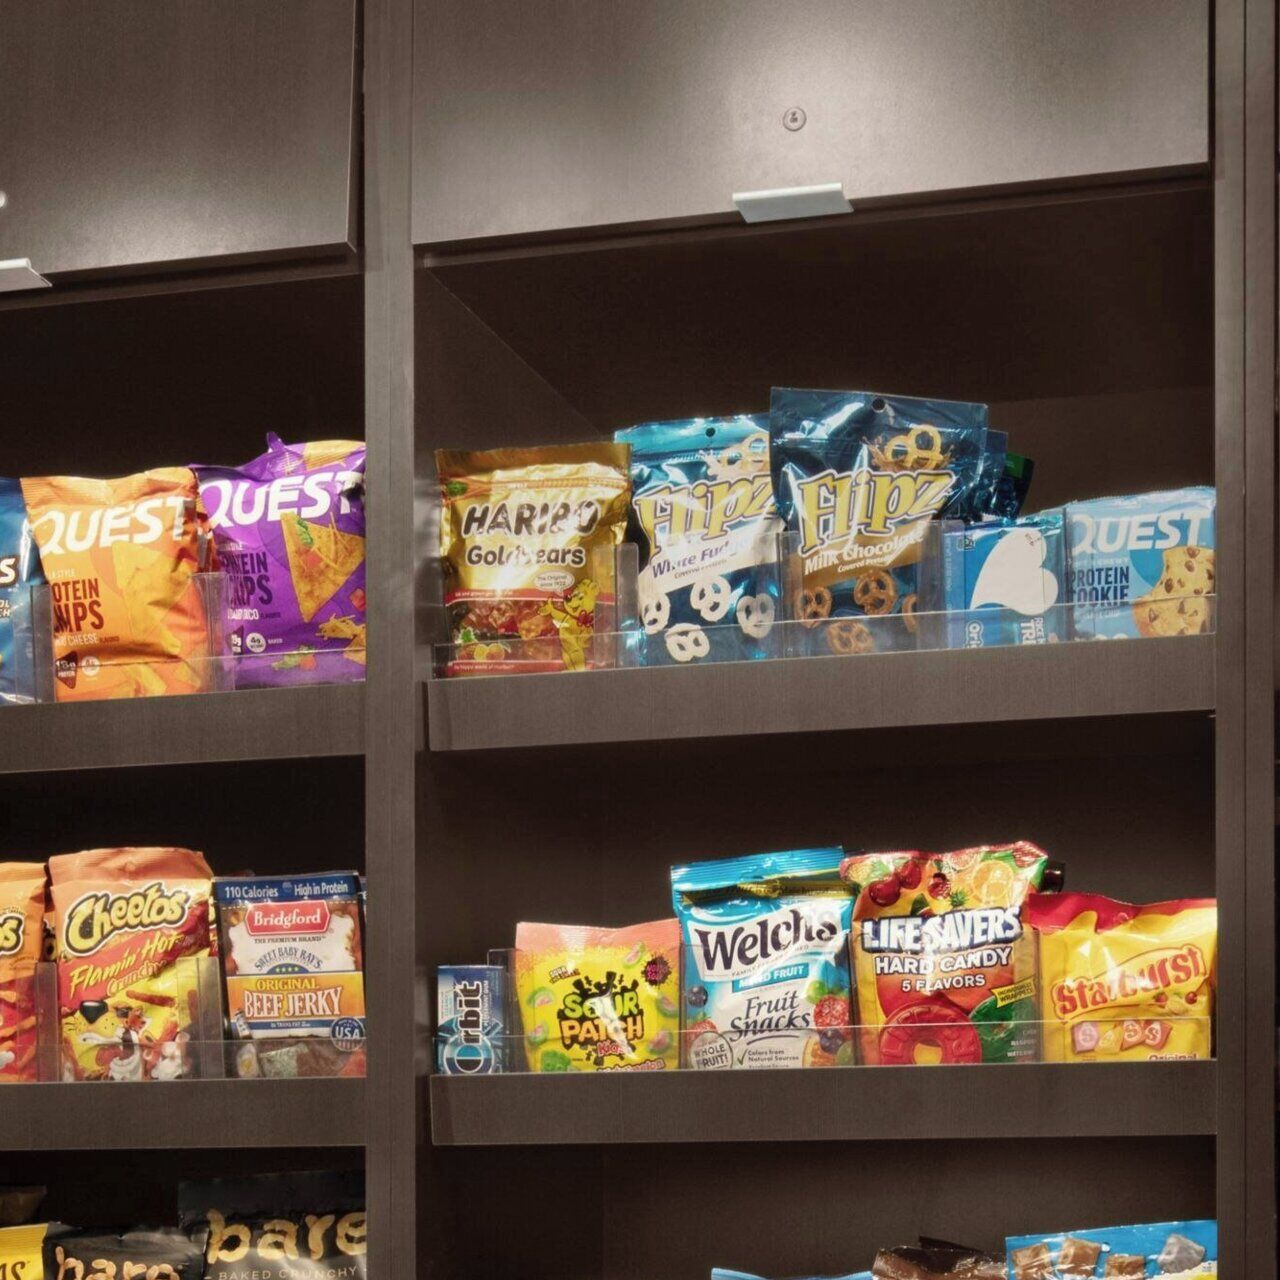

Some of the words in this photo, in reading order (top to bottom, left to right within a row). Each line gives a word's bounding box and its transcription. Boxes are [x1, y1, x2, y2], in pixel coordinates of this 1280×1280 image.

[199, 471, 365, 528] QUEST
[799, 470, 956, 556] Flipz
[32, 497, 195, 556] QUEST
[462, 500, 599, 538] HARIBO
[1071, 509, 1210, 556] QUEST
[805, 551, 839, 575] Milk
[225, 886, 240, 898] 110
[242, 886, 278, 898] Calories
[294, 884, 310, 896] High
[321, 881, 348, 893] Protein
[66, 883, 189, 953] Cheetos
[253, 908, 321, 928] Bridgford
[864, 918, 922, 952] LIFE
[923, 907, 1021, 950] SAVERS
[277, 946, 299, 956] BABY
[876, 955, 935, 976] HARD
[941, 945, 1013, 971] CANDY
[256, 977, 320, 990] ORIGINAL
[773, 965, 804, 980] FRUIT
[902, 980, 911, 992] 5
[915, 974, 986, 991] FLAVORS
[245, 990, 283, 1018] BEEF
[286, 987, 342, 1017] JERKY
[562, 990, 639, 1019] SOUR
[745, 991, 800, 1020] Fruit
[729, 1010, 811, 1042] Snacks
[207, 1209, 367, 1264] bare
[219, 1268, 271, 1280] BAKED
[278, 1266, 357, 1279] CRUNCHY
